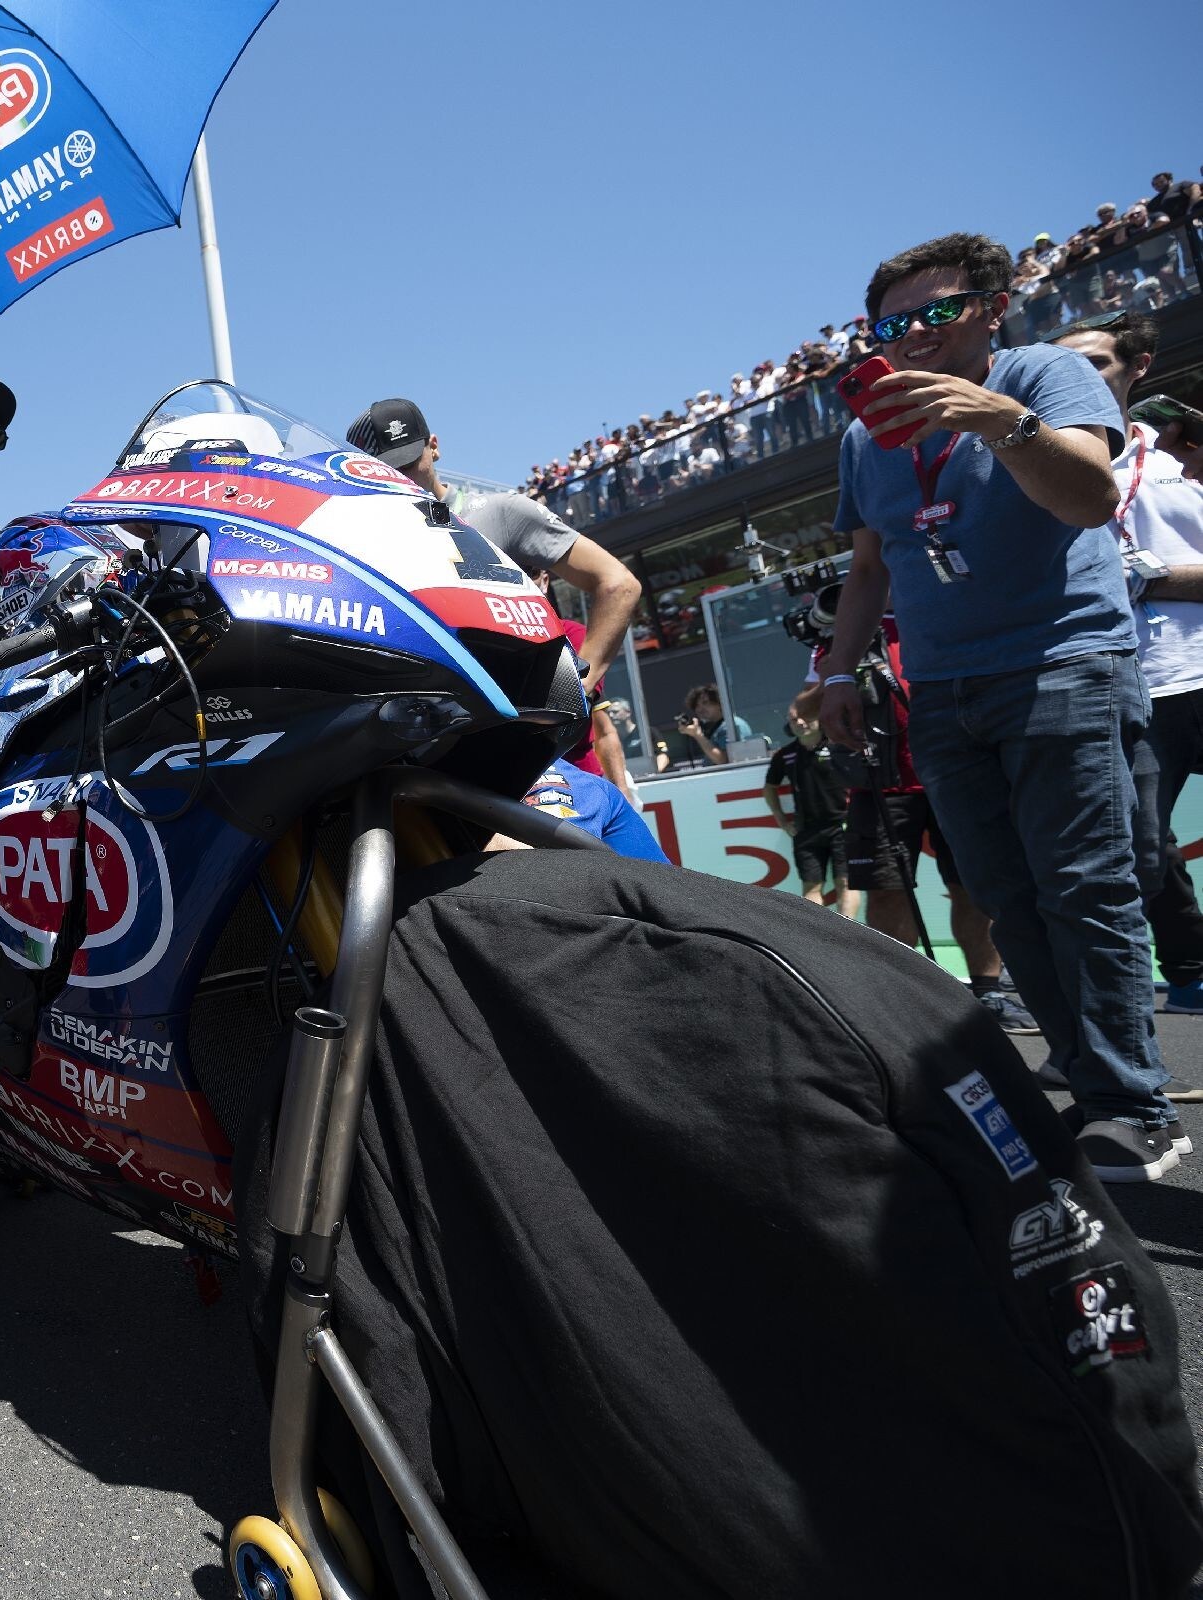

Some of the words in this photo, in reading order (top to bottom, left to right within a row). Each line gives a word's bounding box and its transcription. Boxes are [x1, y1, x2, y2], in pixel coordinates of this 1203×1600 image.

[218, 524, 290, 553] Corpay
[213, 561, 329, 580] McAMS
[239, 588, 386, 636] YAMAHA
[486, 597, 549, 625] BMP
[509, 623, 550, 638] TAPPI
[205, 708, 253, 723] GILLES
[73, 1036, 170, 1072] DEPAN
[59, 1058, 146, 1108] BMP
[72, 1093, 127, 1120] TAPPI
